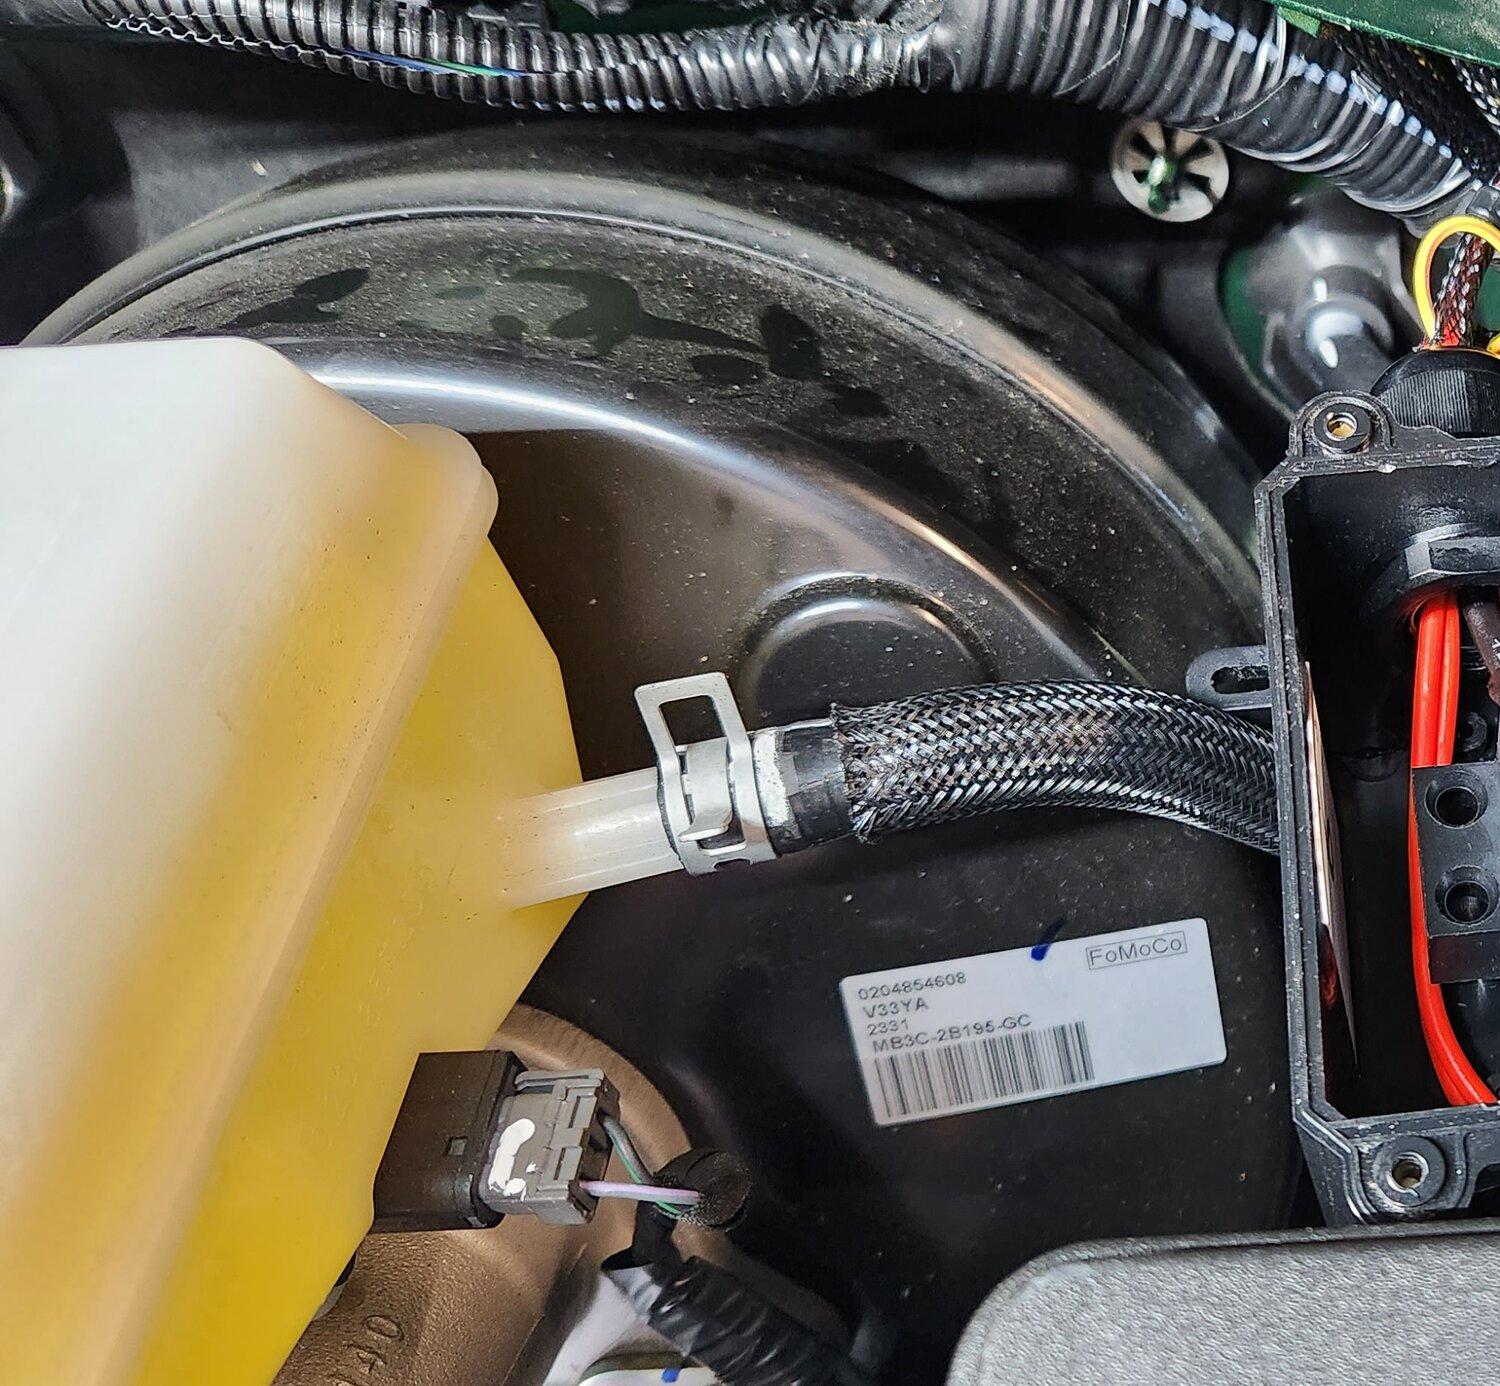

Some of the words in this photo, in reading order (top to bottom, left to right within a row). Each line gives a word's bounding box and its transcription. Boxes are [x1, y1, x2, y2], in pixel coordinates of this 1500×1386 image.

[1089, 938, 1182, 966] FoMoCo
[857, 971, 967, 1001] 0204854608
[863, 997, 931, 1019] V33YA
[867, 1018, 910, 1037] 2331
[873, 1013, 1033, 1053] MB3C-2B195-GC
